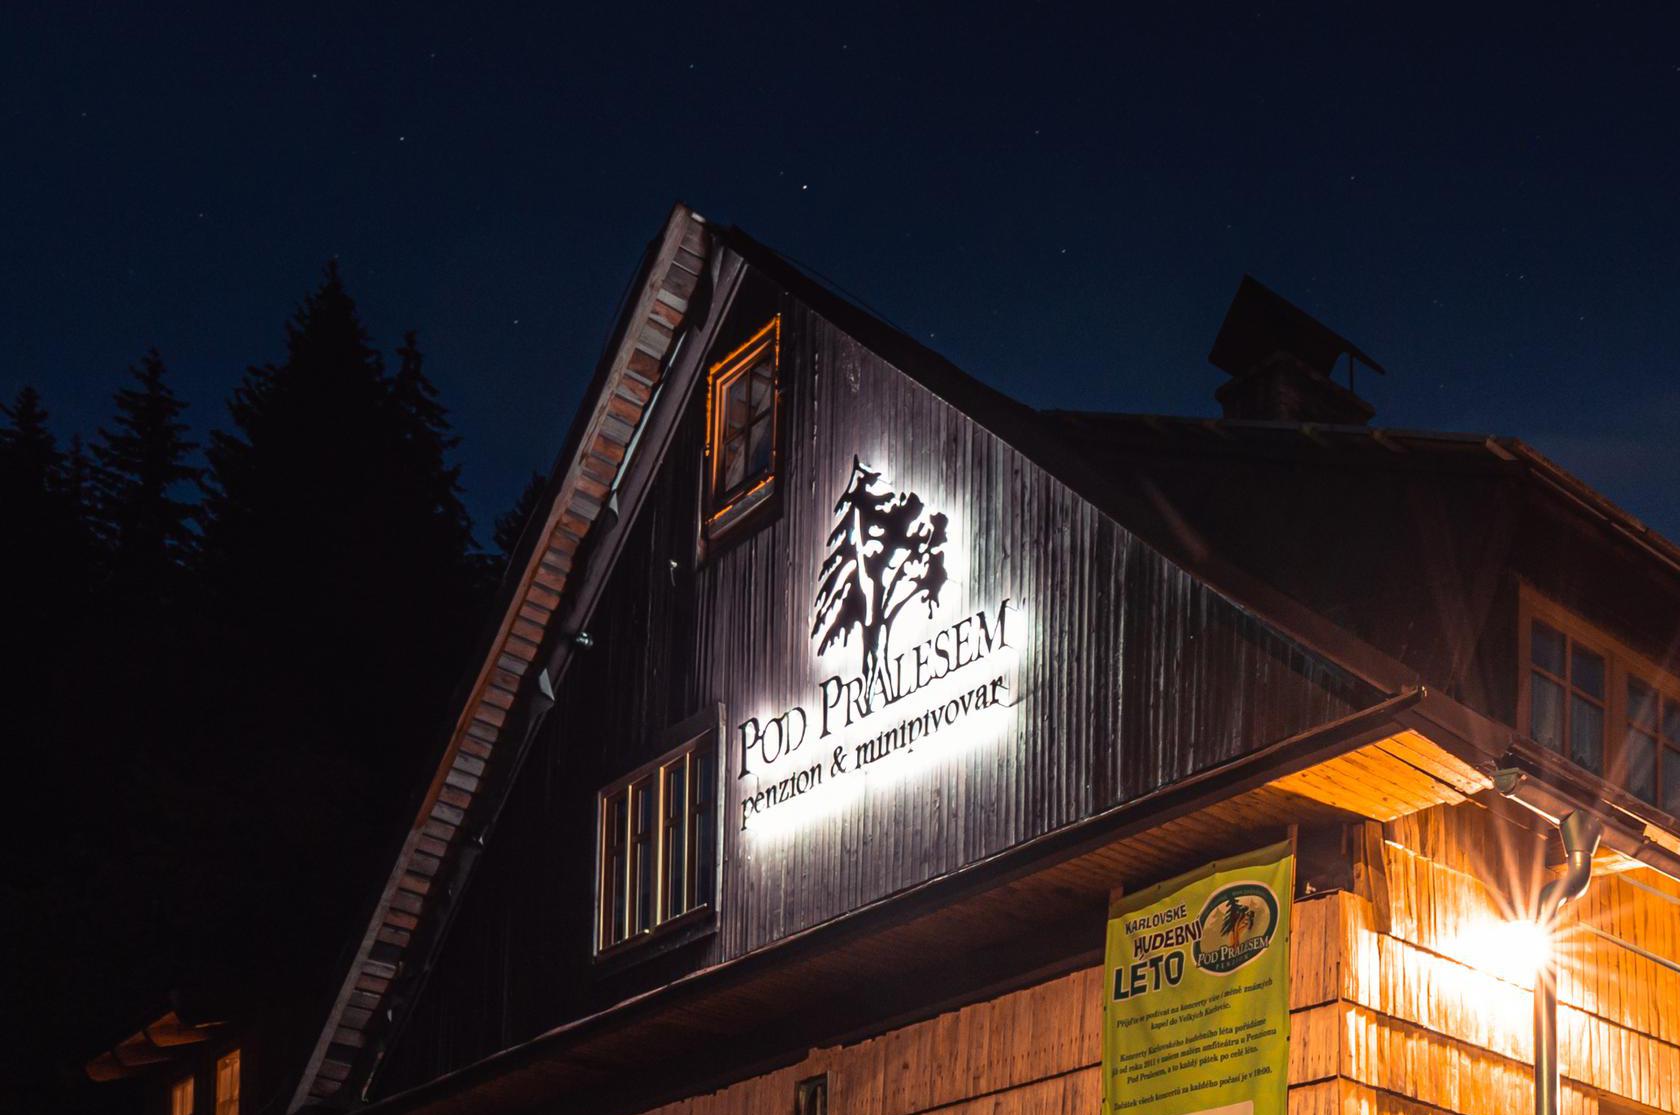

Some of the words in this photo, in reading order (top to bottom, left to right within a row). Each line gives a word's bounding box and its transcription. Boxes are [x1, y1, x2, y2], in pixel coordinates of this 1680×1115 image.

[741, 763, 822, 831] penzion
[830, 745, 847, 778] &
[855, 676, 1003, 769] minipivovar
[1198, 951, 1219, 966] POD
[1114, 950, 1185, 1000] LÉTO
[1220, 1054, 1230, 1062] po
